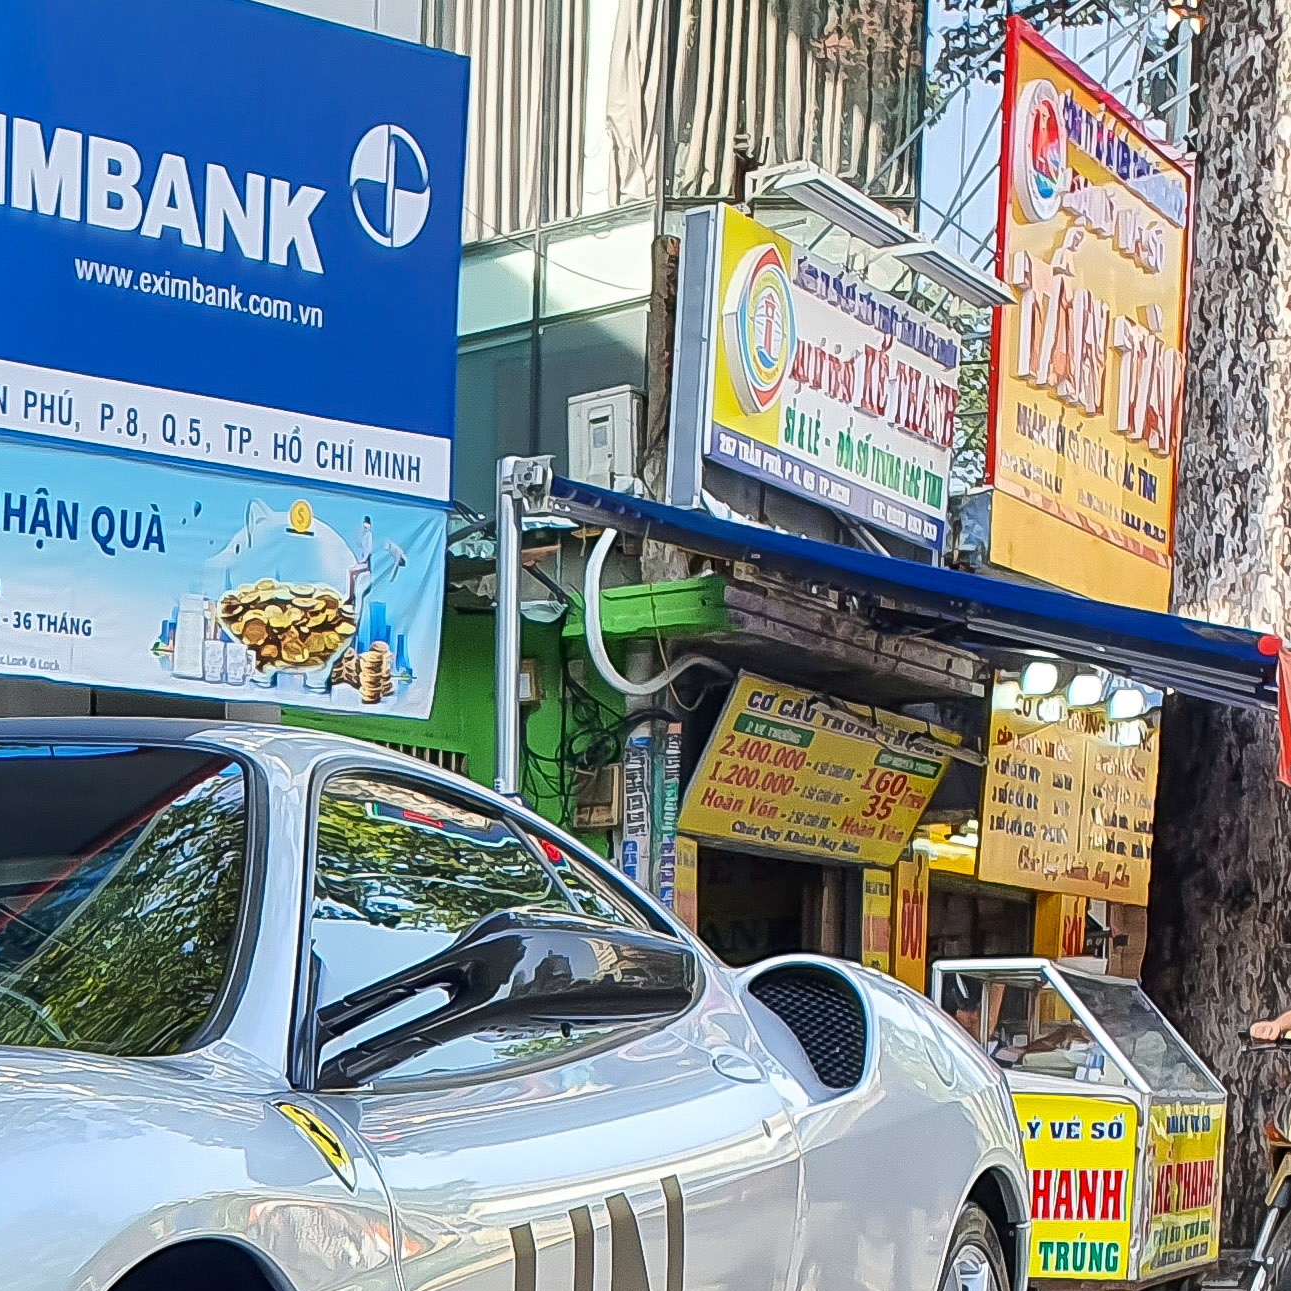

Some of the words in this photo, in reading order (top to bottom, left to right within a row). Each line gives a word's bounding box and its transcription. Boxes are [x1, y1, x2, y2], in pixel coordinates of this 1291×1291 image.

[74, 257, 324, 328] www.eximbank.com.vn
[23, 389, 81, 433] PHÚ,
[100, 403, 148, 444] P.8,
[162, 413, 211, 453] Q.5,
[224, 423, 259, 457] TP.
[273, 426, 302, 464] HỒ
[317, 439, 355, 473] CHÍ
[364, 448, 422, 483] MINH
[91, 503, 166, 556] QUÀ
[13, 611, 32, 630] 36
[37, 612, 93, 637] THÁNG
[747, 690, 779, 711] CƠ
[719, 734, 807, 771] 2.400.000
[709, 761, 795, 796] 1.200.000
[860, 767, 908, 796] 160
[862, 795, 898, 820] 35
[1021, 1115, 1043, 1140] Ý
[1050, 1115, 1082, 1139] VÉ
[1091, 1113, 1125, 1140] SỐ
[1038, 1233, 1120, 1272] TRÚNG
